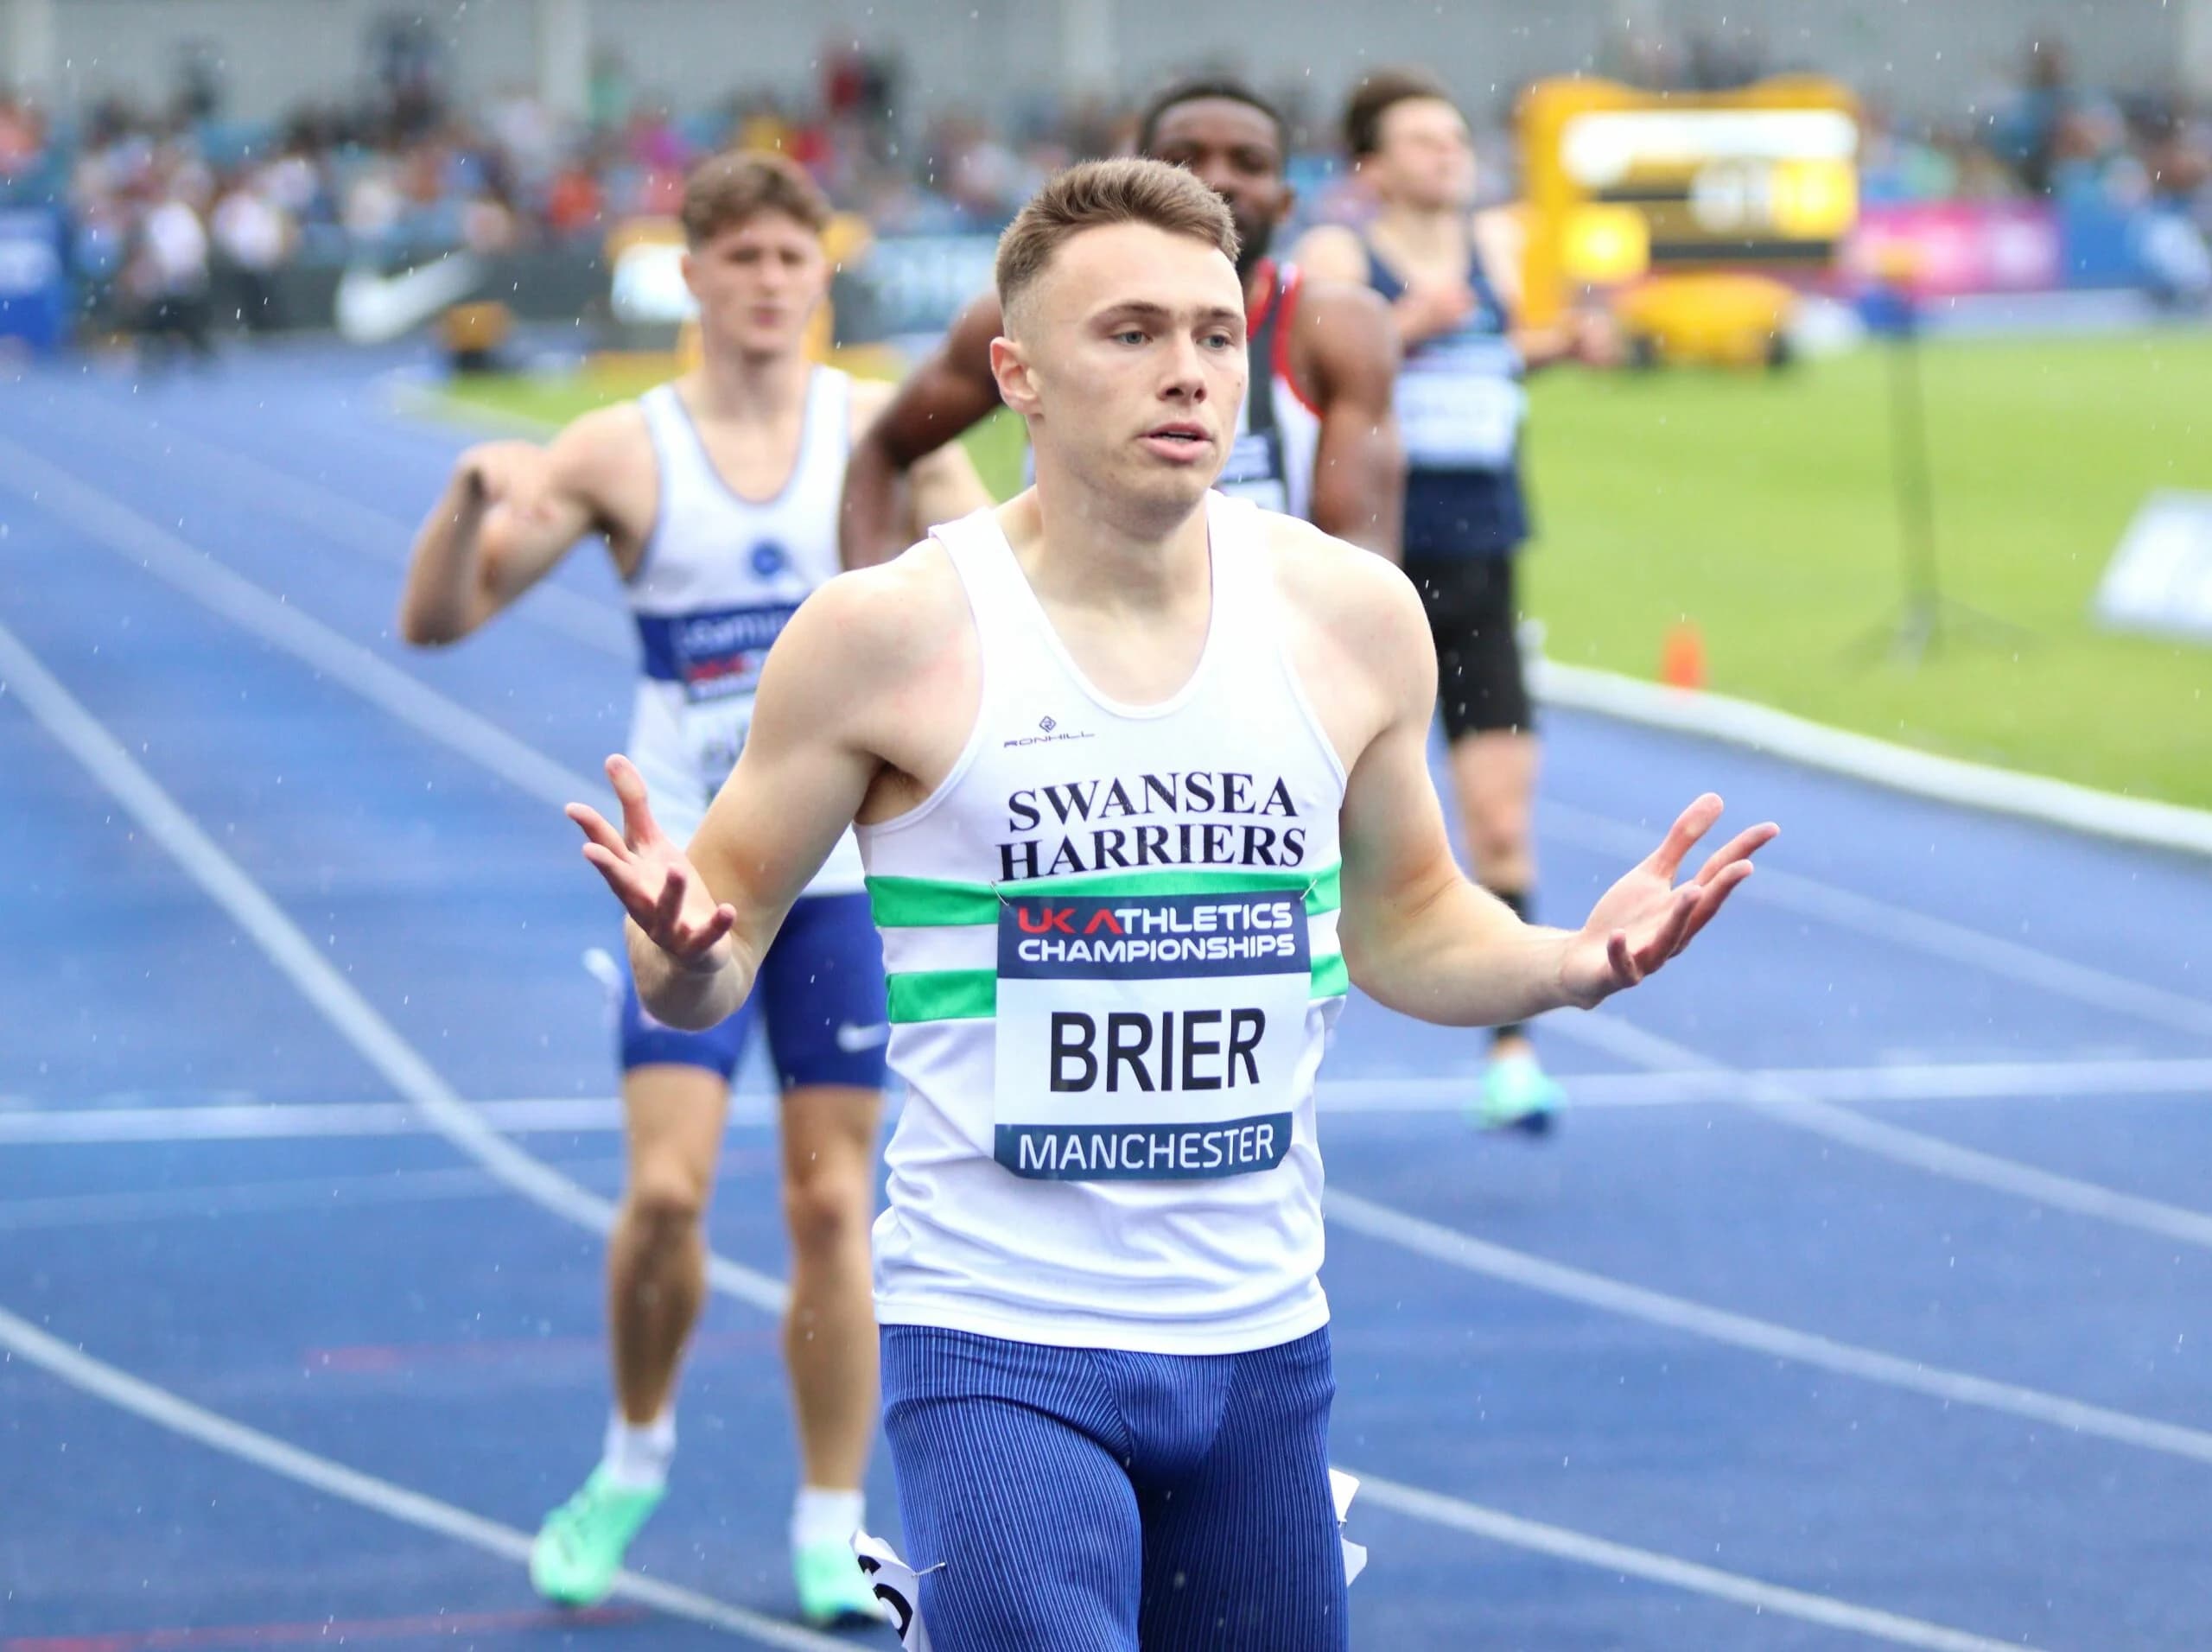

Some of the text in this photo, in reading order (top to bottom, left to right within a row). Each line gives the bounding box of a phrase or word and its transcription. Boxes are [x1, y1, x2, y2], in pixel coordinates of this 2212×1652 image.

[1003, 730, 1095, 748] RONHILL
[1008, 772, 1299, 833] SWANSEA
[995, 824, 1306, 881] HARRIERS
[1018, 902, 1293, 934] UK ATHLETICS
[1018, 934, 1296, 963] CHAMPIONSHIPS
[1051, 1007, 1266, 1092] BRIER
[1019, 1124, 1274, 1170] MANCHESTER
